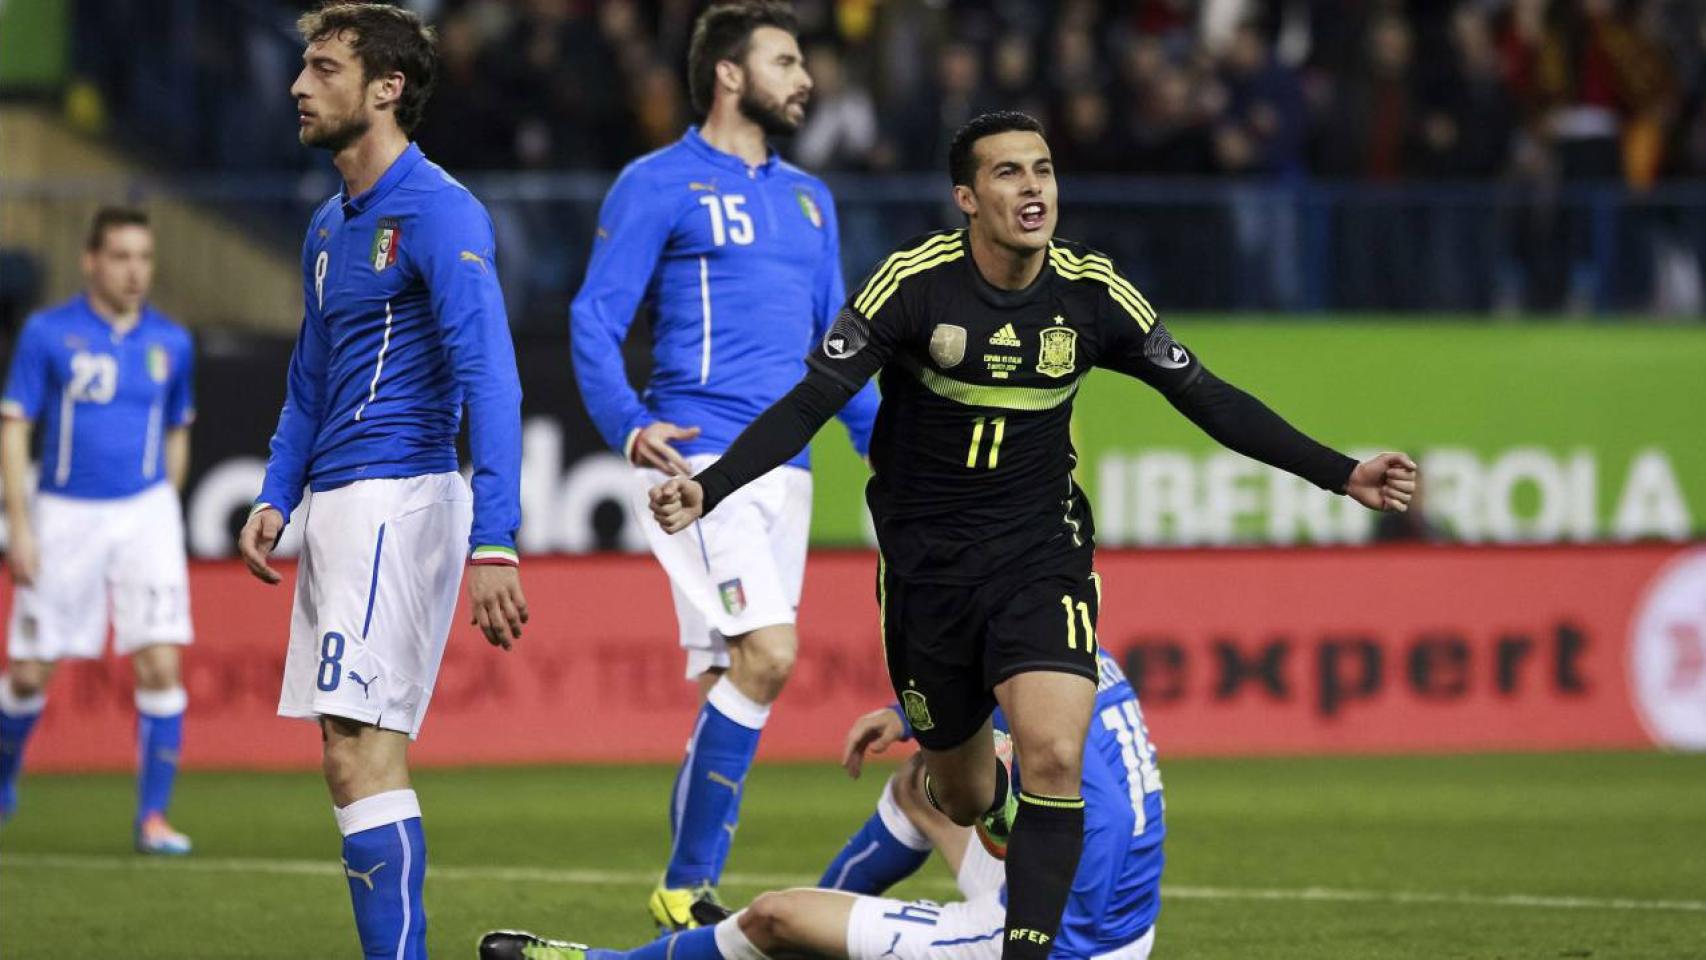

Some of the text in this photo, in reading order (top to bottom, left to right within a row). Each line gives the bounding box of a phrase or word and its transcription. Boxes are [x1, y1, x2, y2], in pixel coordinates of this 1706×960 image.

[699, 195, 755, 247] 15
[989, 337, 1021, 347] adidas
[70, 350, 118, 404] 23
[966, 416, 1006, 469] 11
[1061, 595, 1094, 654] 11
[316, 631, 345, 692] 8
[1127, 618, 1586, 714] expert
[1009, 928, 1050, 945] RFEF
